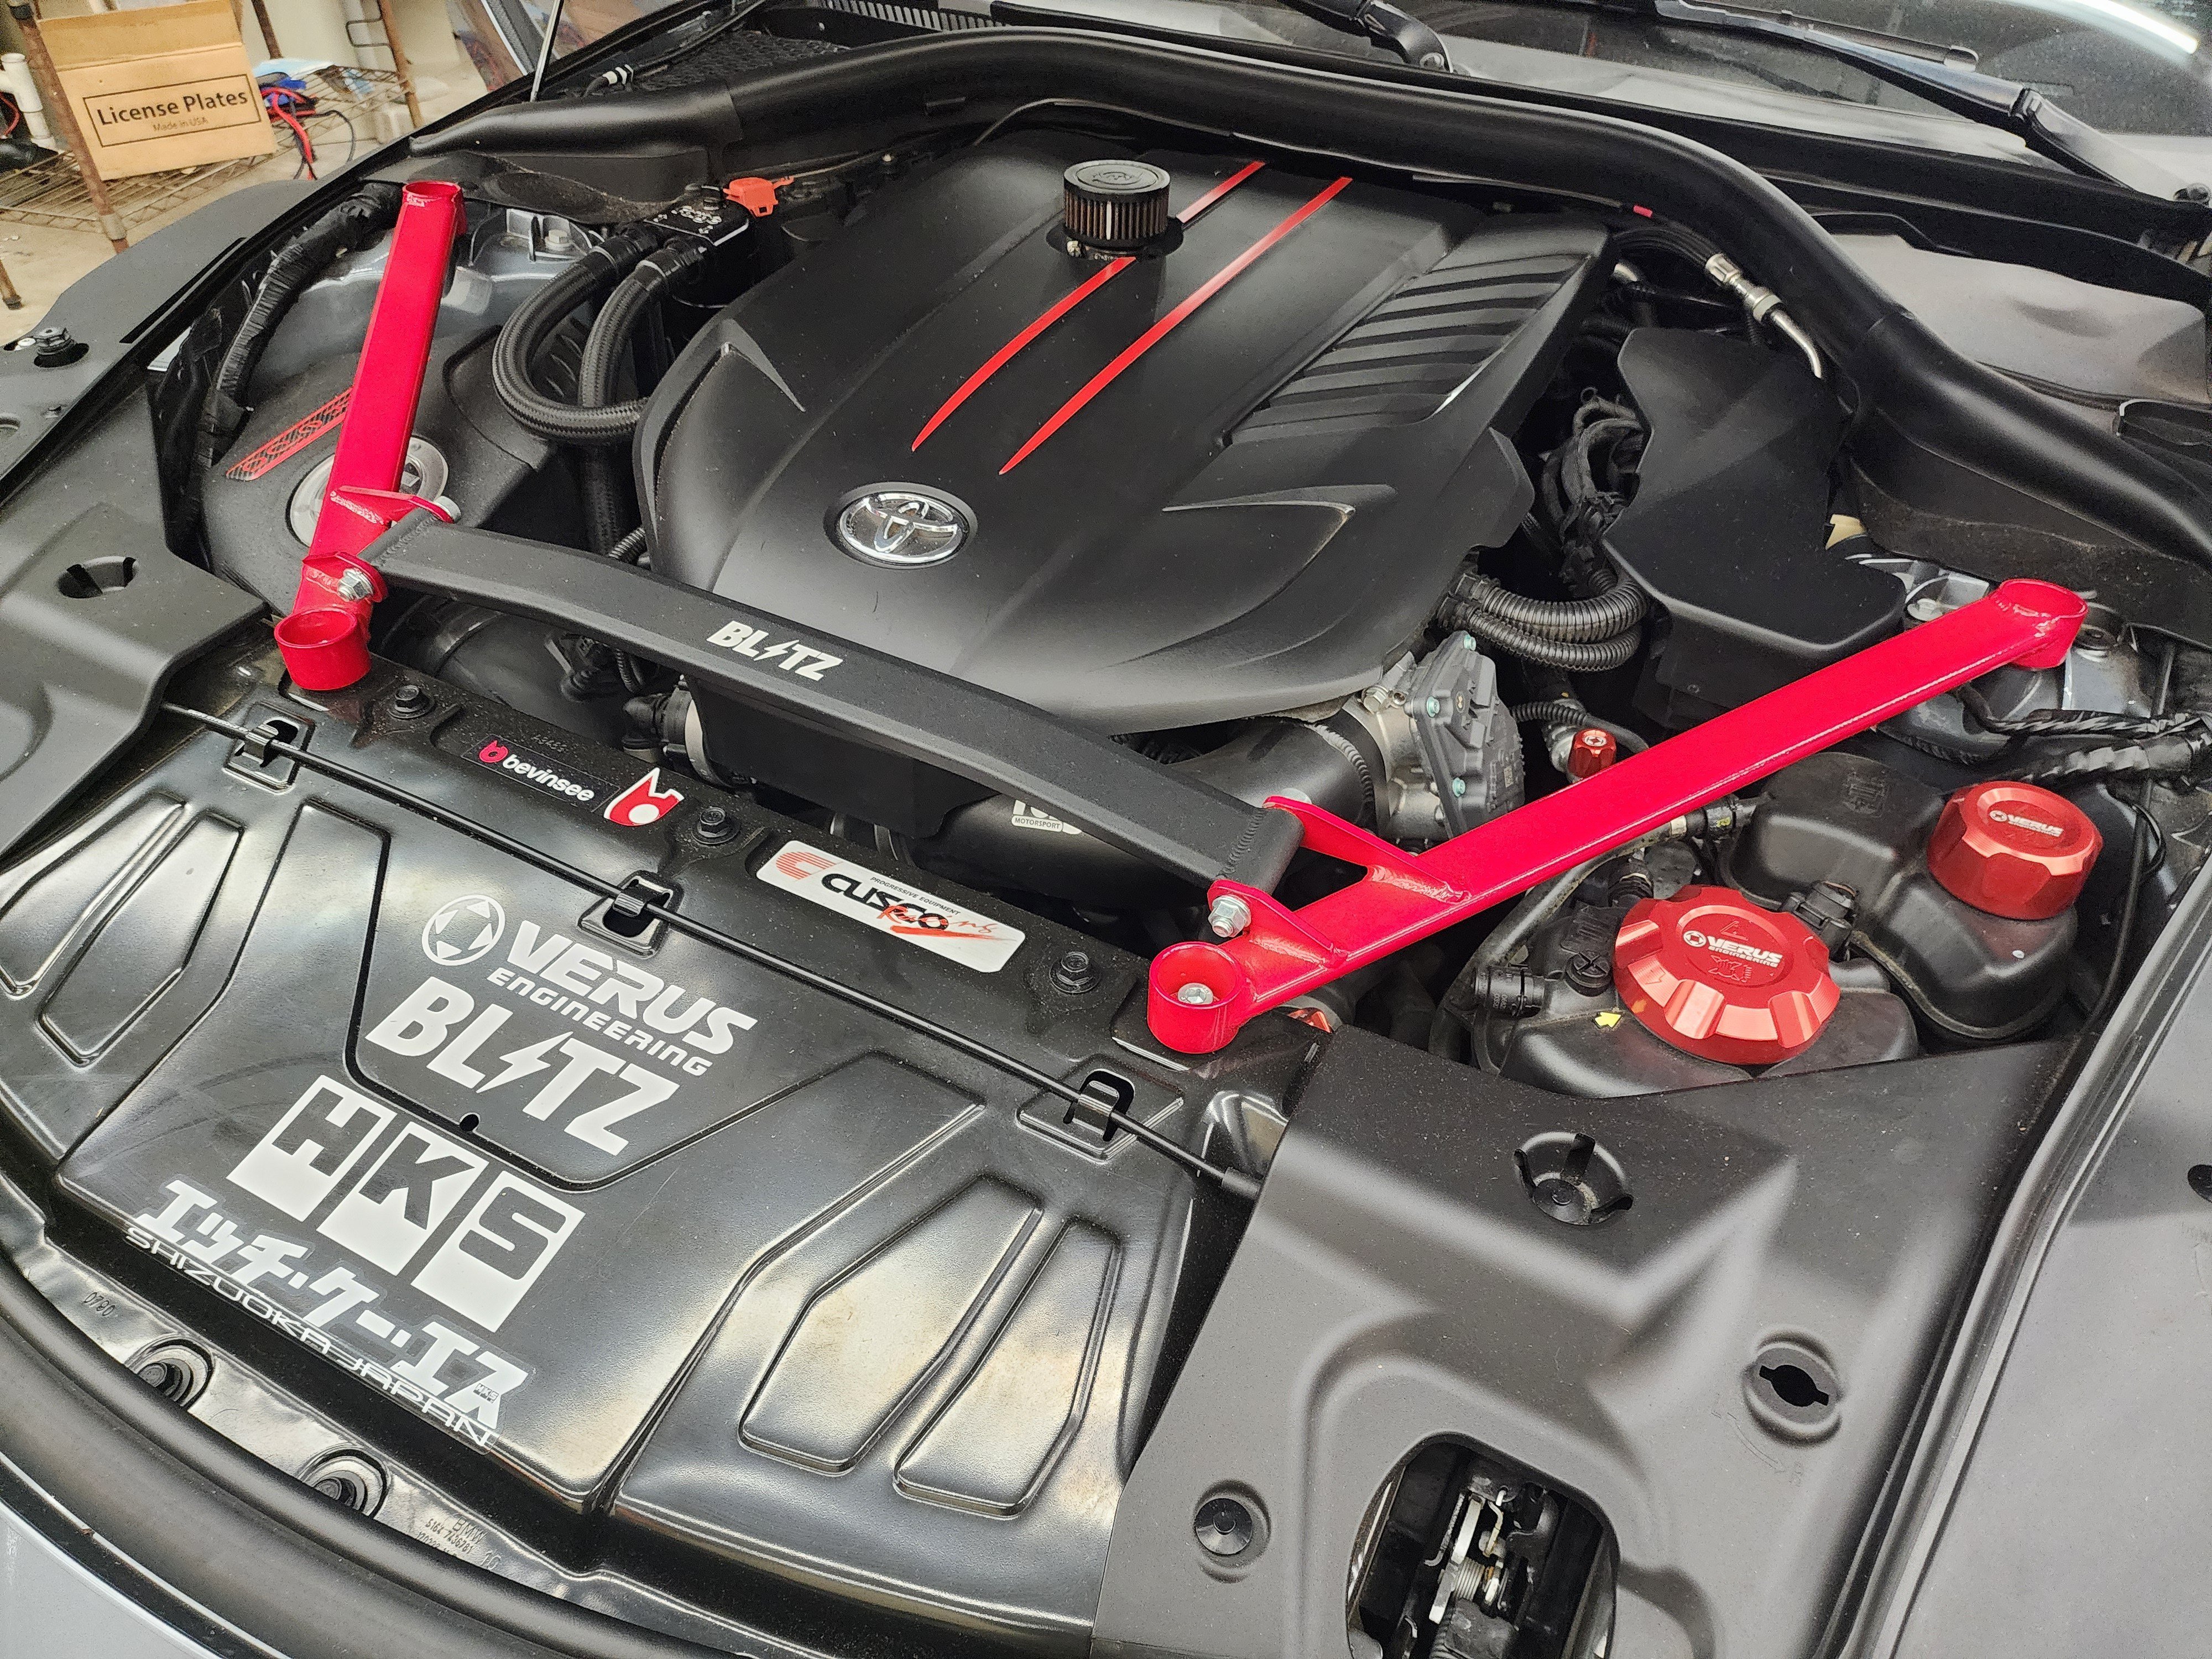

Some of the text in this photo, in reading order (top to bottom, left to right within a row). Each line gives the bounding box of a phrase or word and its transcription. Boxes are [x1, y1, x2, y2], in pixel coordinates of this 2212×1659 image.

[97, 92, 248, 126] License Plates
[153, 115, 208, 132] Made in USA
[502, 754, 594, 801] bevinsee
[1014, 817, 1061, 830] MOTORSPORT
[2007, 813, 2064, 834] VERUS
[821, 873, 950, 931] CUSCO
[870, 876, 961, 916] PROGRESSIVE EQUIPMENT
[1707, 935, 1783, 963] VERUS
[507, 920, 758, 1055] VERUS
[226, 1075, 586, 1333] HKS
[126, 1227, 492, 1447] SHIZUOKA JAPAN
[473, 1383, 499, 1404] HKS
[452, 1517, 488, 1545] BMW
